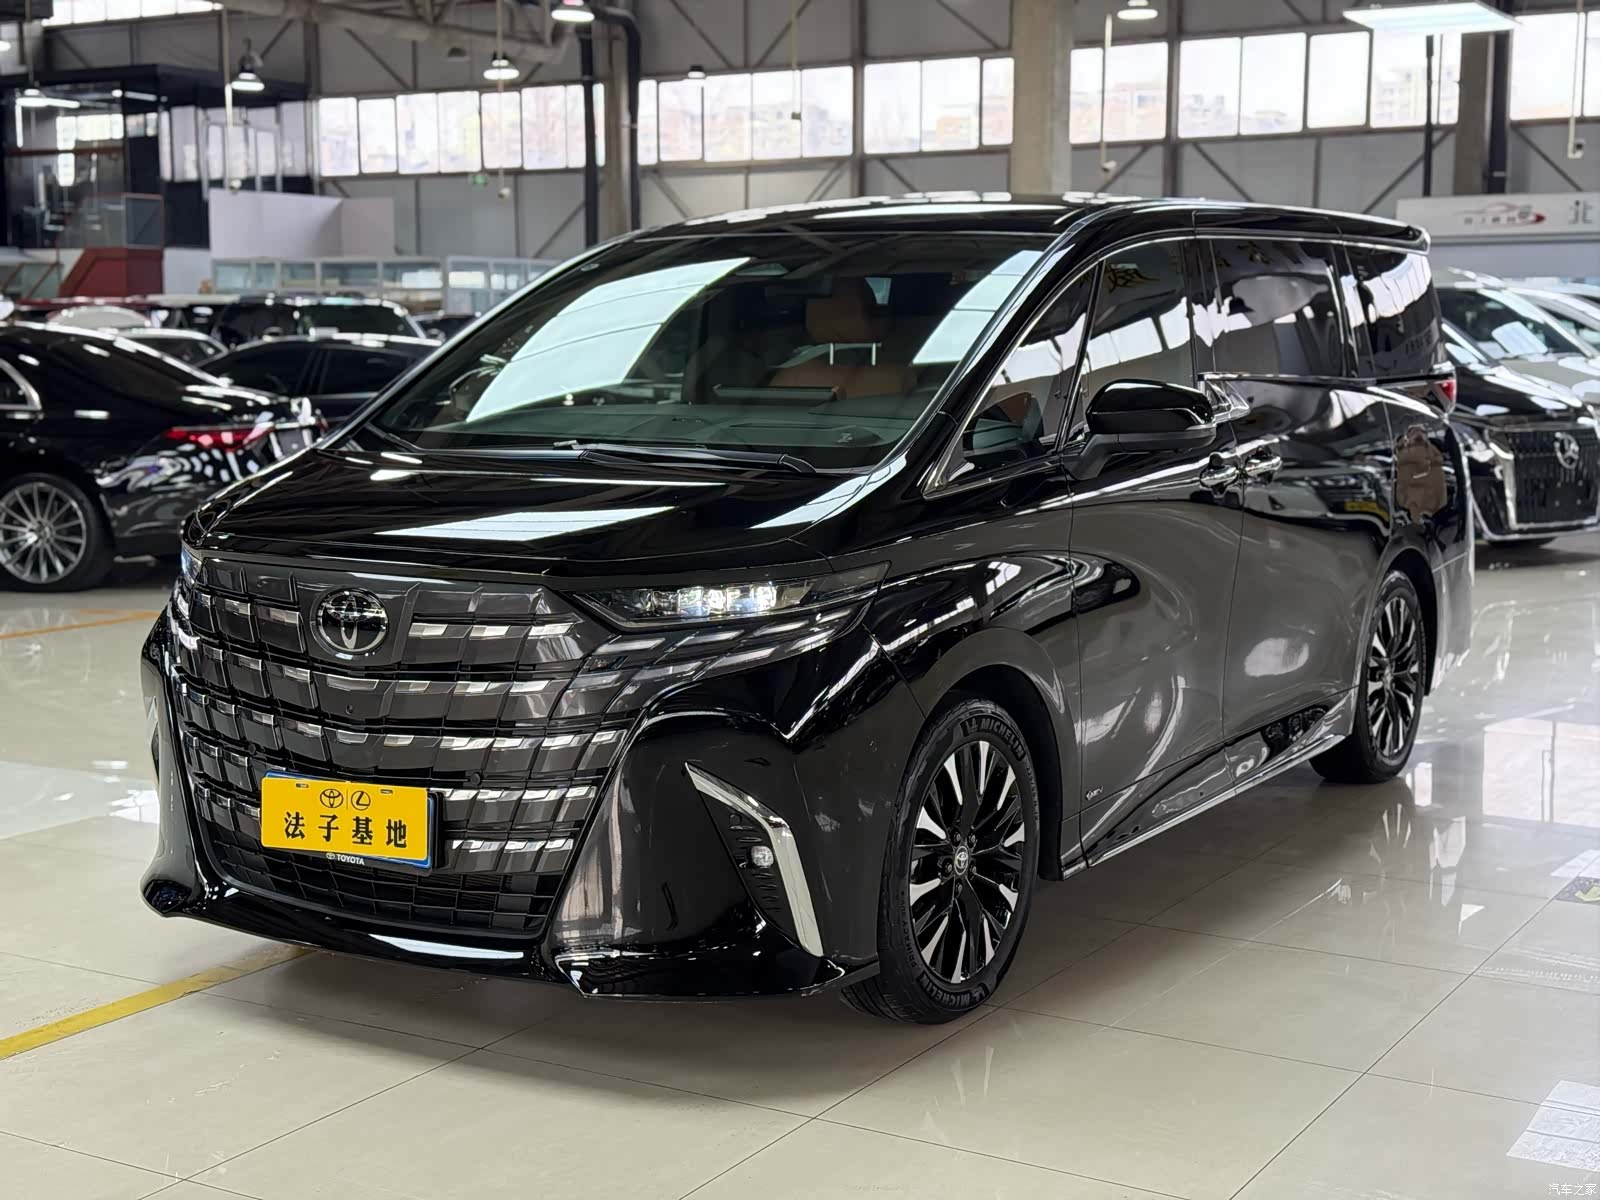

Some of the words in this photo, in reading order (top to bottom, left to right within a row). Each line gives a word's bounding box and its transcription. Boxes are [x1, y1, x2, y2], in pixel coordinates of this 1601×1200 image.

[980, 718, 1025, 759] MICHELIN
[283, 811, 408, 848] 法子基地
[335, 853, 365, 865] TOYOTA
[902, 921, 917, 968] PRIMACY
[919, 973, 971, 1007] MICHELIN
